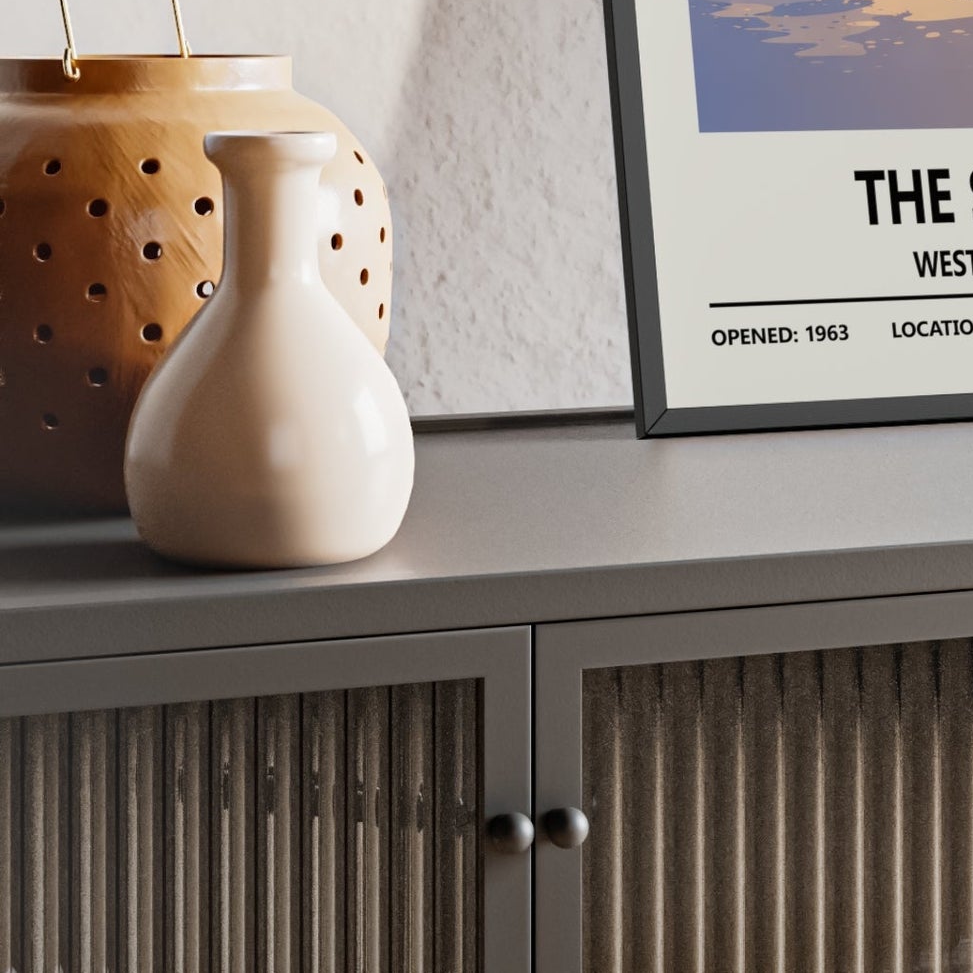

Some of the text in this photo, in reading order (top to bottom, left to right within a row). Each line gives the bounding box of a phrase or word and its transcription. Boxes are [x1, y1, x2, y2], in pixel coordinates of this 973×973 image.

[854, 169, 956, 225] THE
[711, 324, 849, 347] OPENED: 1963
